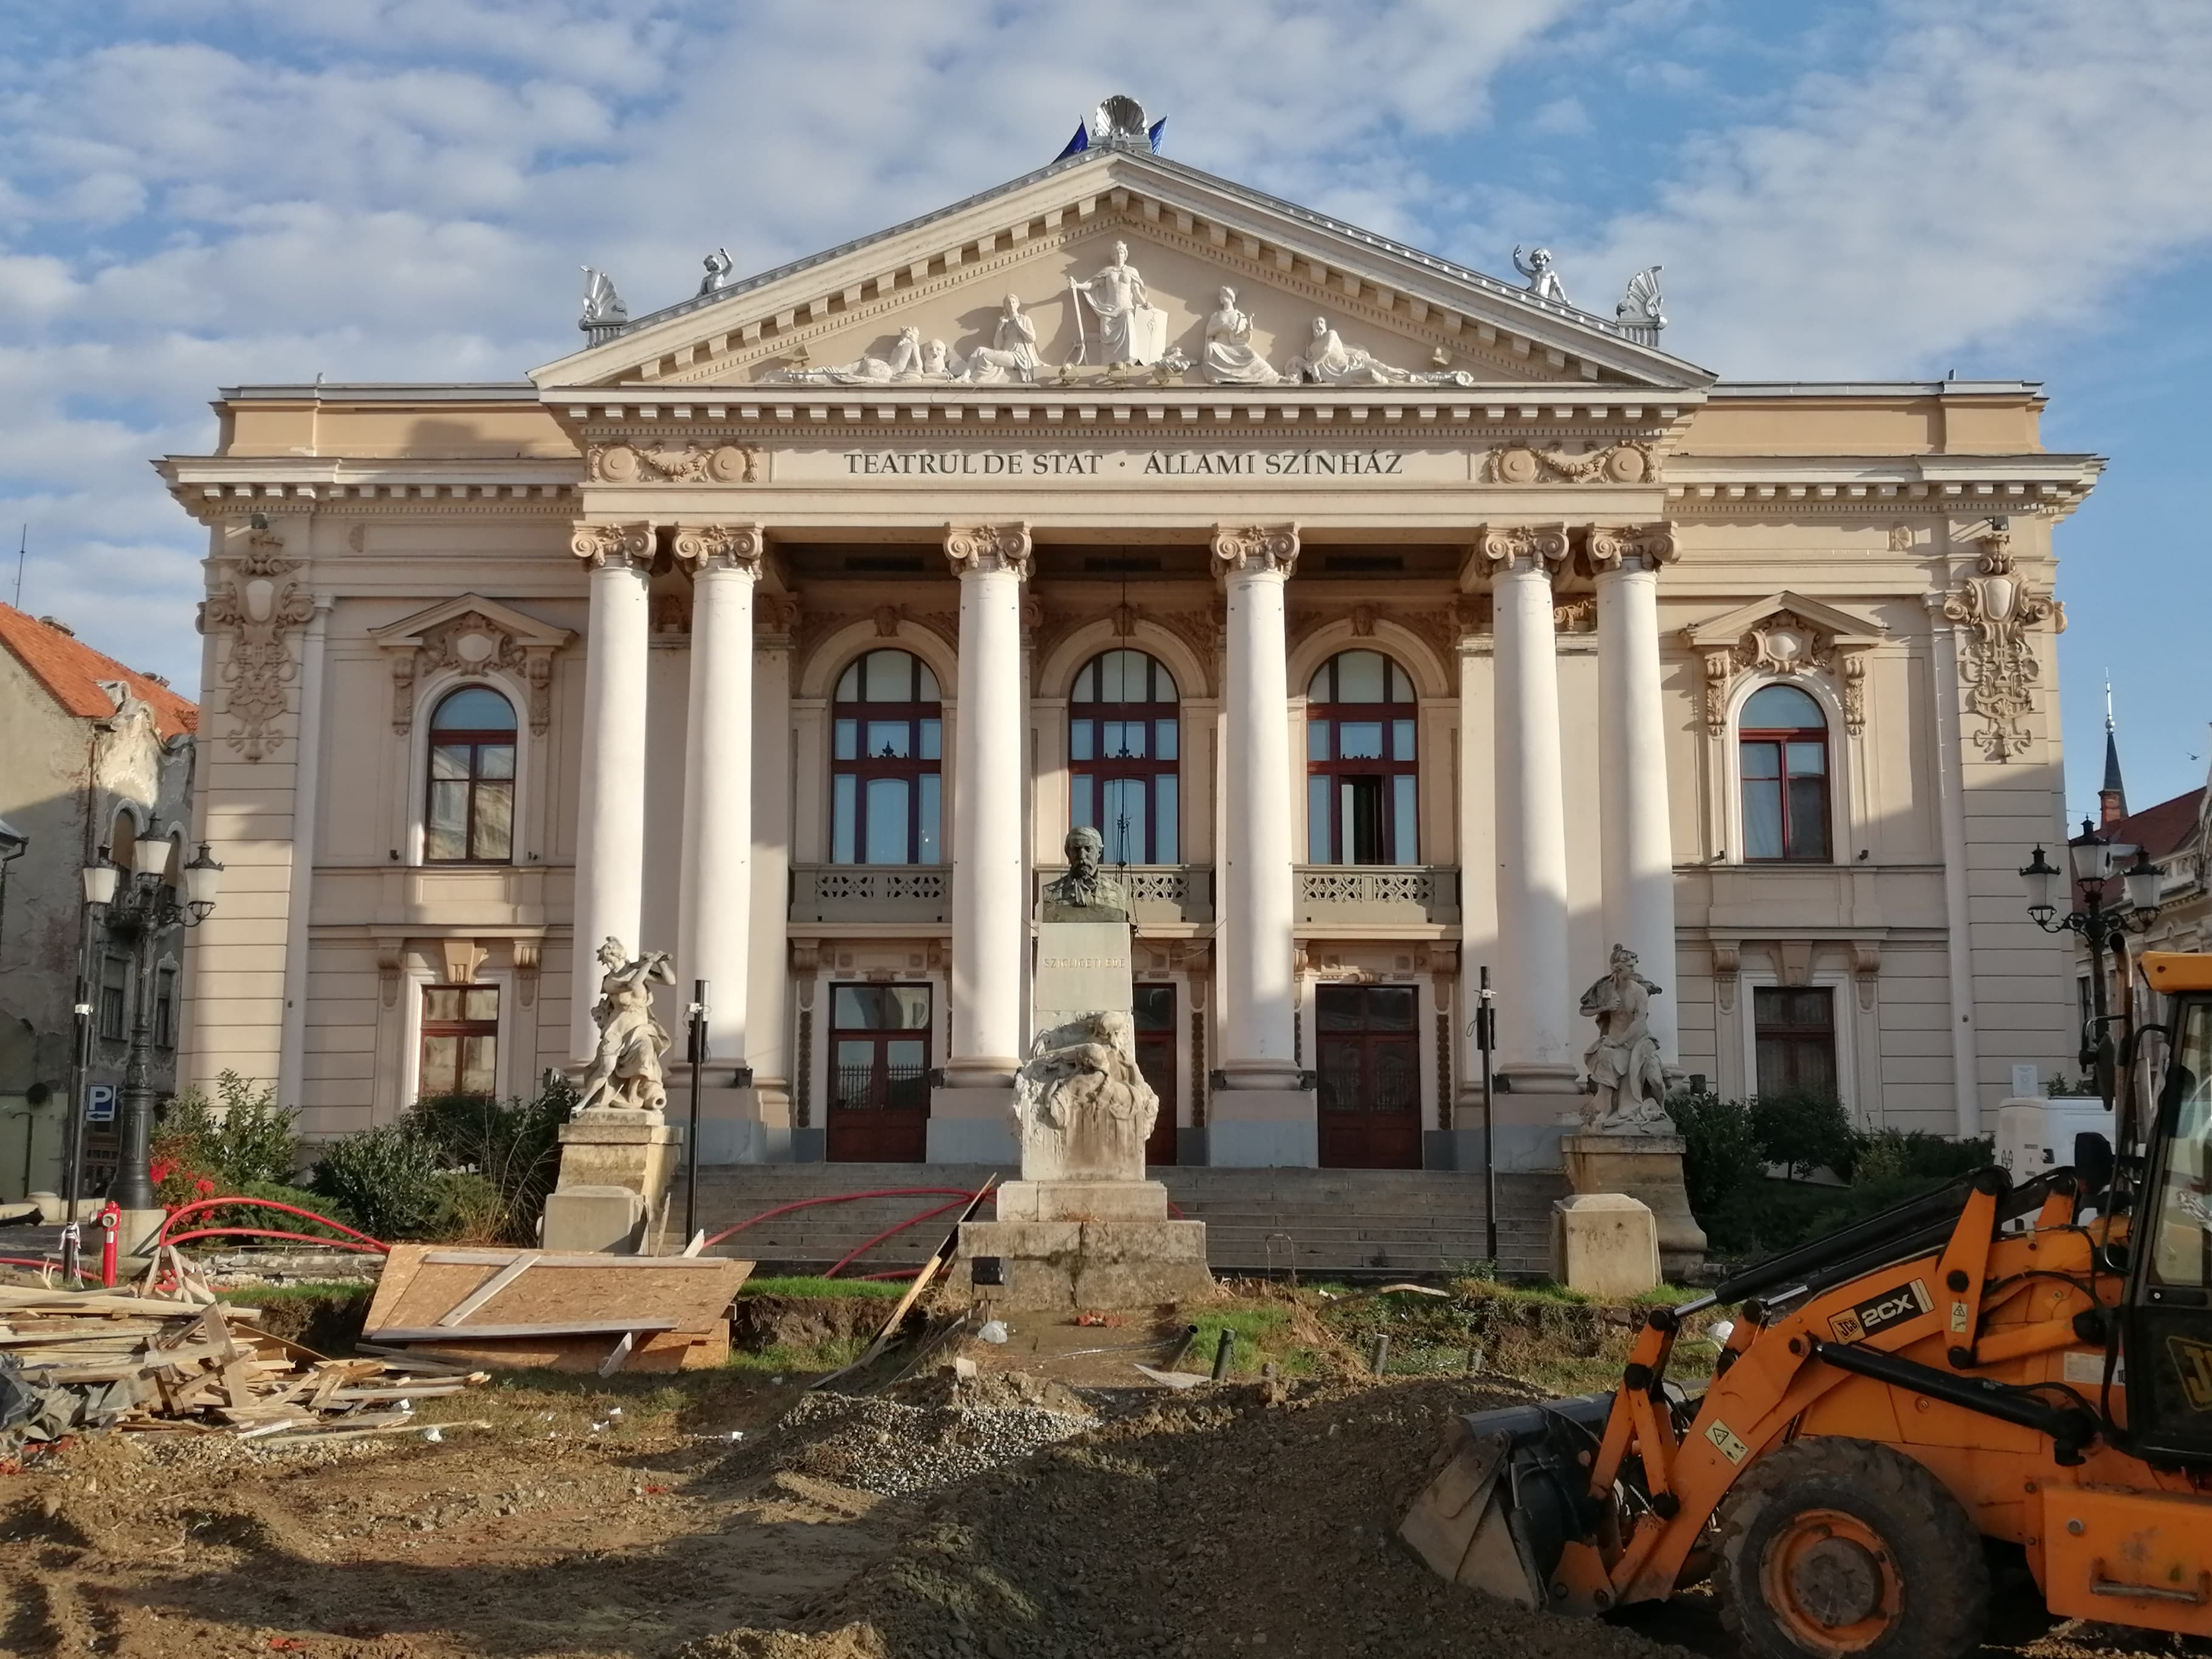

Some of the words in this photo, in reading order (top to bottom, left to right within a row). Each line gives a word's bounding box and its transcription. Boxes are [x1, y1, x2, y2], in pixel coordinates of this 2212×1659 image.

[843, 453, 977, 475] TEATRUL
[983, 454, 1023, 475] DE
[1032, 454, 1103, 475] STAT
[1142, 449, 1255, 475] ÁLLAMI
[1265, 448, 1403, 475] SZÍNHÁZ
[1043, 958, 1102, 968] SZIGLIGETI
[1105, 958, 1125, 968] EDE
[88, 1086, 112, 1111] P
[1836, 1319, 1858, 1336] JCB
[1861, 1293, 1915, 1328] 2CX
[2182, 1345, 2212, 1404] J
